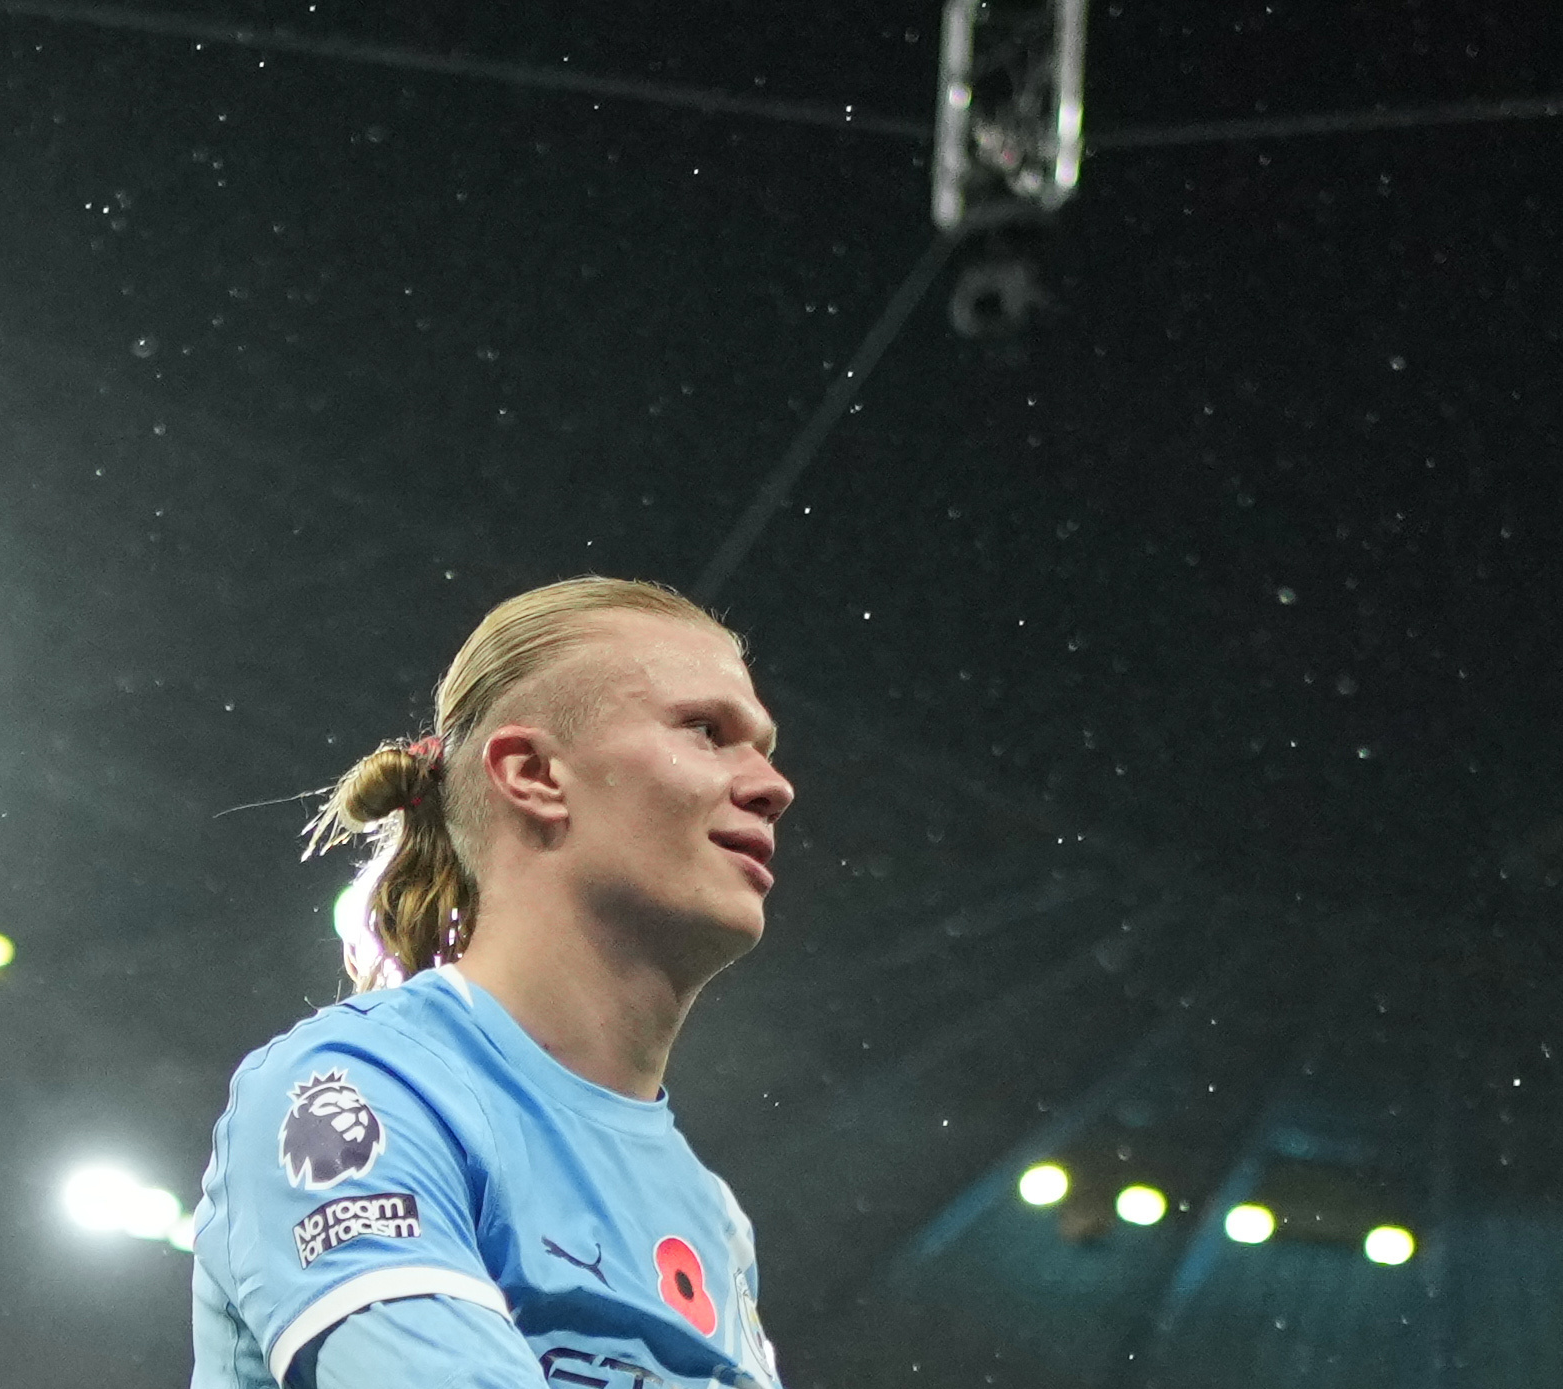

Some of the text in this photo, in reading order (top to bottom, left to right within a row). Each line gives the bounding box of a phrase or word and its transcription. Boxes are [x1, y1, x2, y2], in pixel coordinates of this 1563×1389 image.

[294, 1198, 404, 1248] No room
[299, 1218, 422, 1269] for racism
